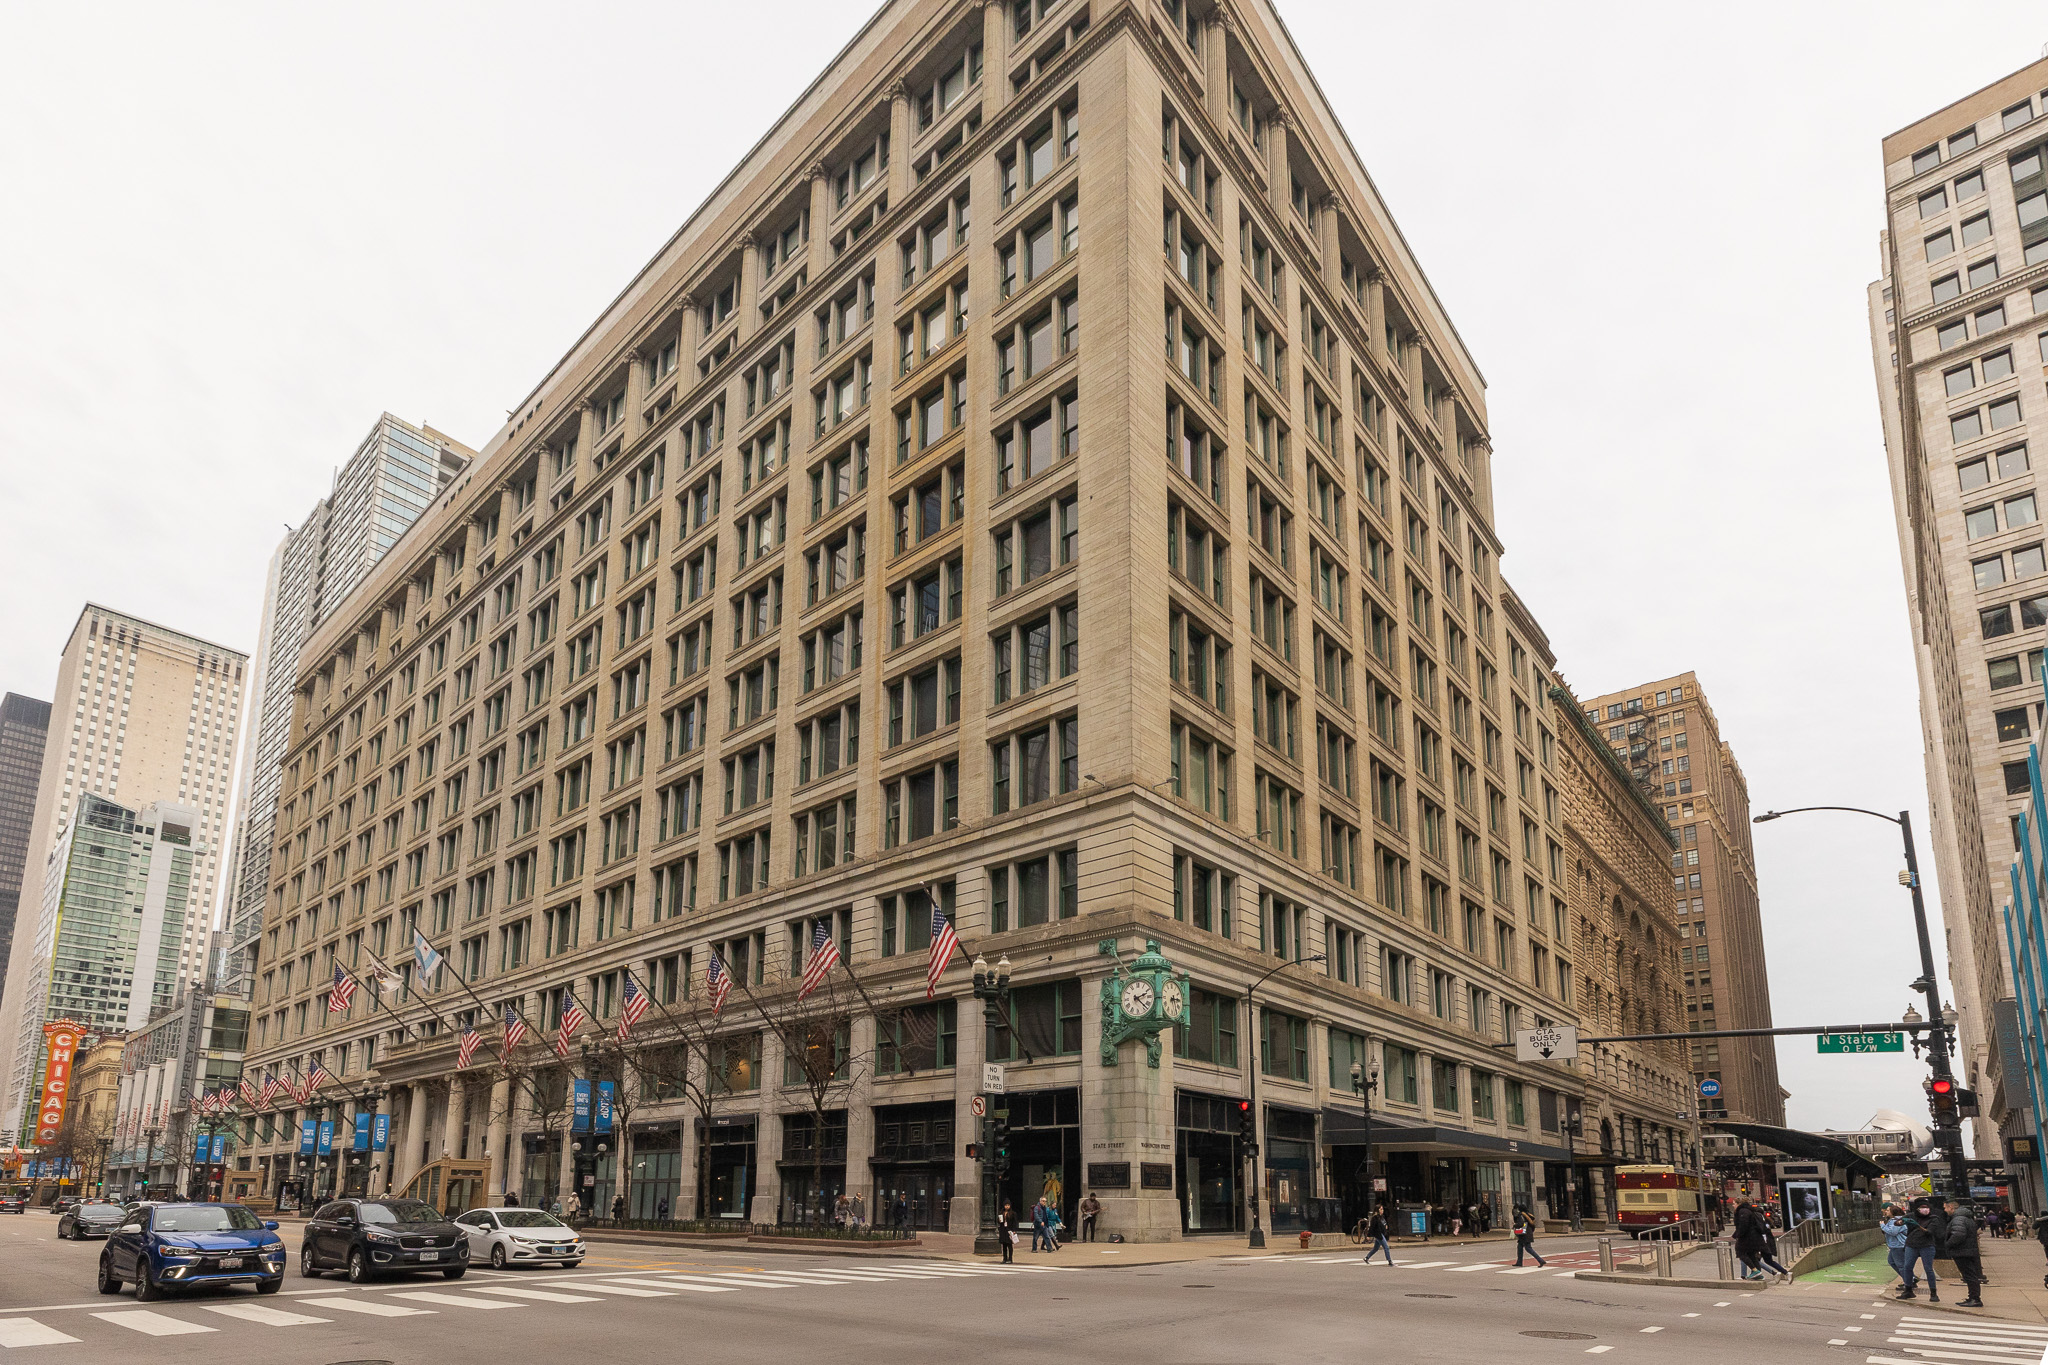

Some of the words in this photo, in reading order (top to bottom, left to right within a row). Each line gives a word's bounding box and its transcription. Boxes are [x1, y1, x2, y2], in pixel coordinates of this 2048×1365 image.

[1530, 1033, 1562, 1042] BUSES
[1532, 1040, 1559, 1048] ONLY
[1822, 1035, 1830, 1045] N
[1839, 1034, 1874, 1045] State
[1883, 1033, 1897, 1044] St
[179, 1047, 193, 1107] JOFFREY
[187, 995, 201, 1044] BALLET
[1855, 1044, 1878, 1052] E/W
[40, 1033, 73, 1140] CHICAGO
[158, 1099, 169, 1128] Walgreens
[128, 1107, 138, 1135] Walgreens
[321, 1132, 331, 1146] LOOP
[376, 1128, 386, 1143] LOOP
[213, 1145, 221, 1157] LOOP
